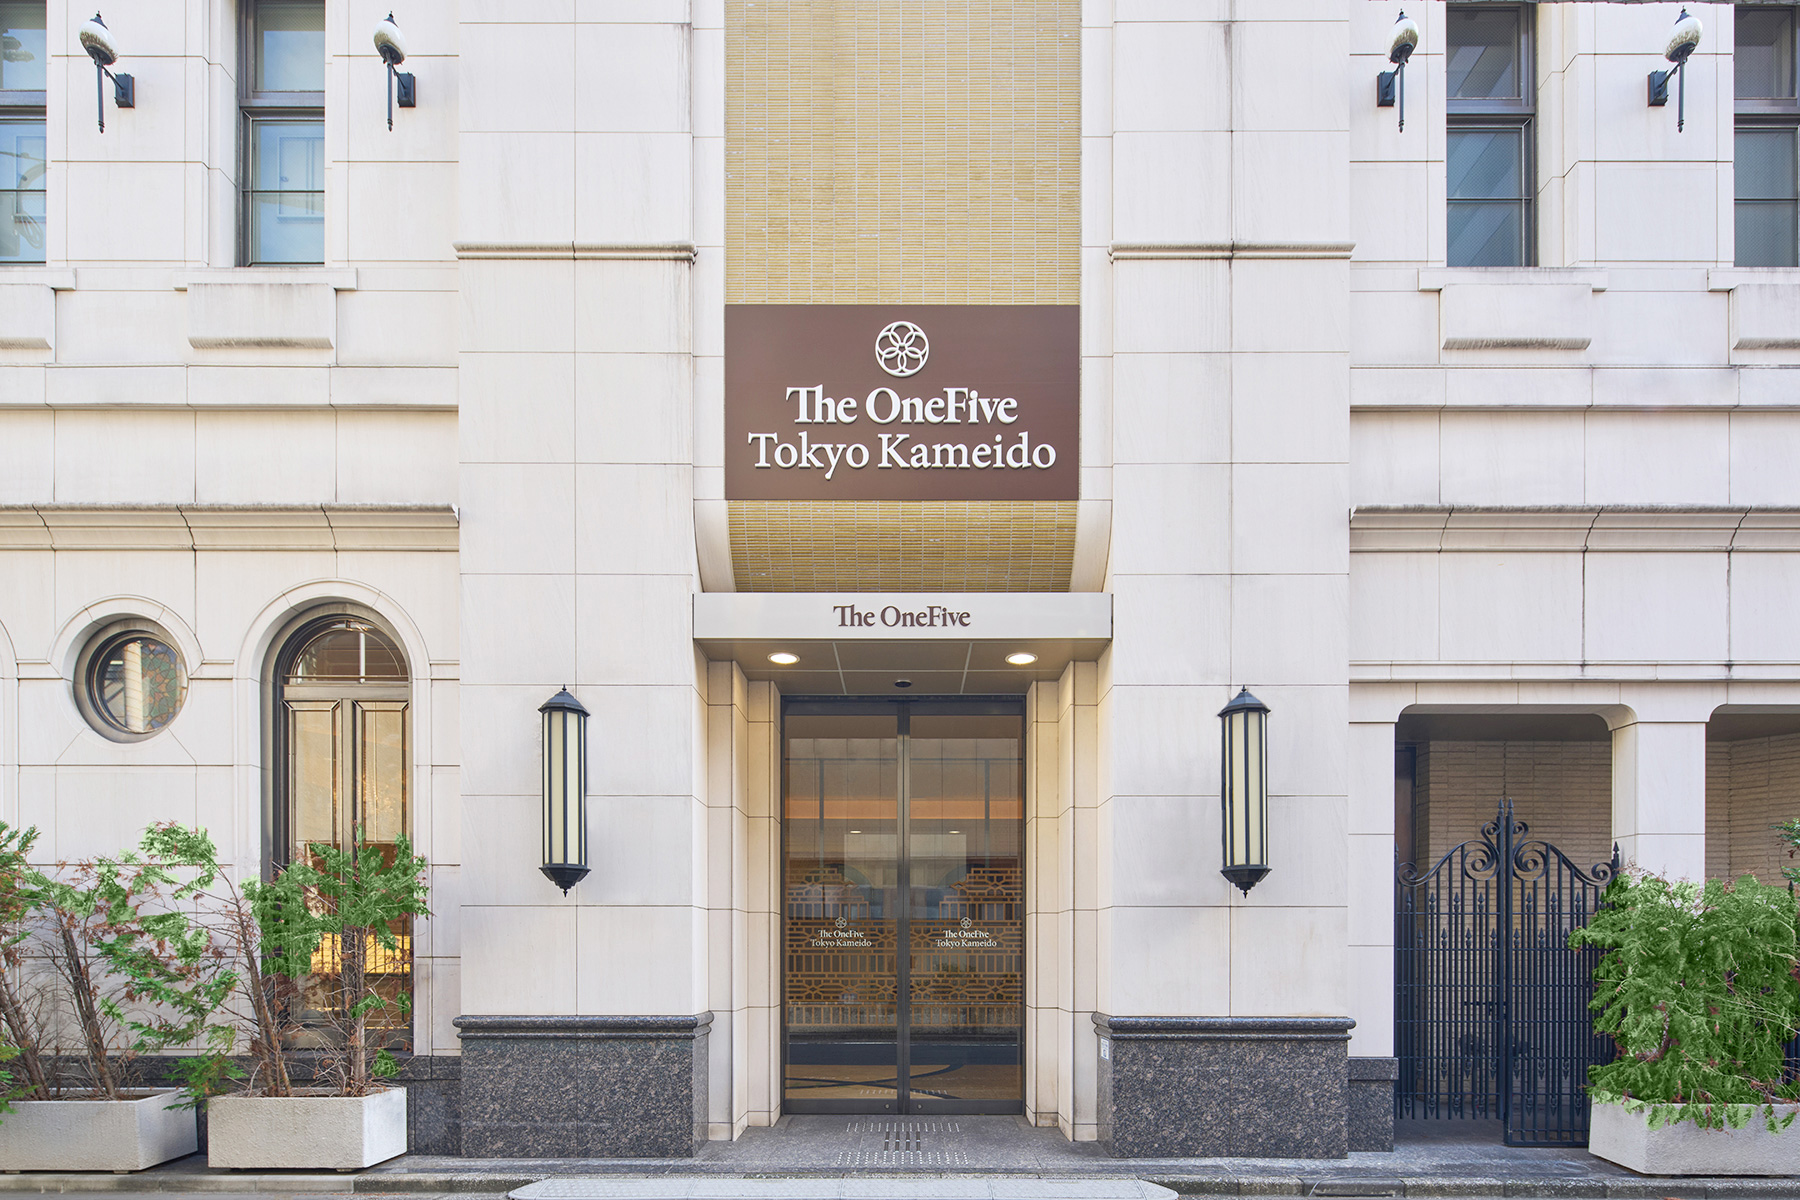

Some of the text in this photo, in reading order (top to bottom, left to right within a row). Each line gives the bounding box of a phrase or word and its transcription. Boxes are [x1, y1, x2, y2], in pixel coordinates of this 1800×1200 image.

[786, 384, 1018, 424] The OneFive
[748, 431, 1057, 480] Tokyo Kameido
[833, 604, 971, 627] The OneFive
[818, 929, 864, 938] The OneFive
[943, 929, 989, 938] The OneFive
[810, 938, 872, 949] Tokyo Kameido
[935, 938, 997, 949] Tokyo Kameido
